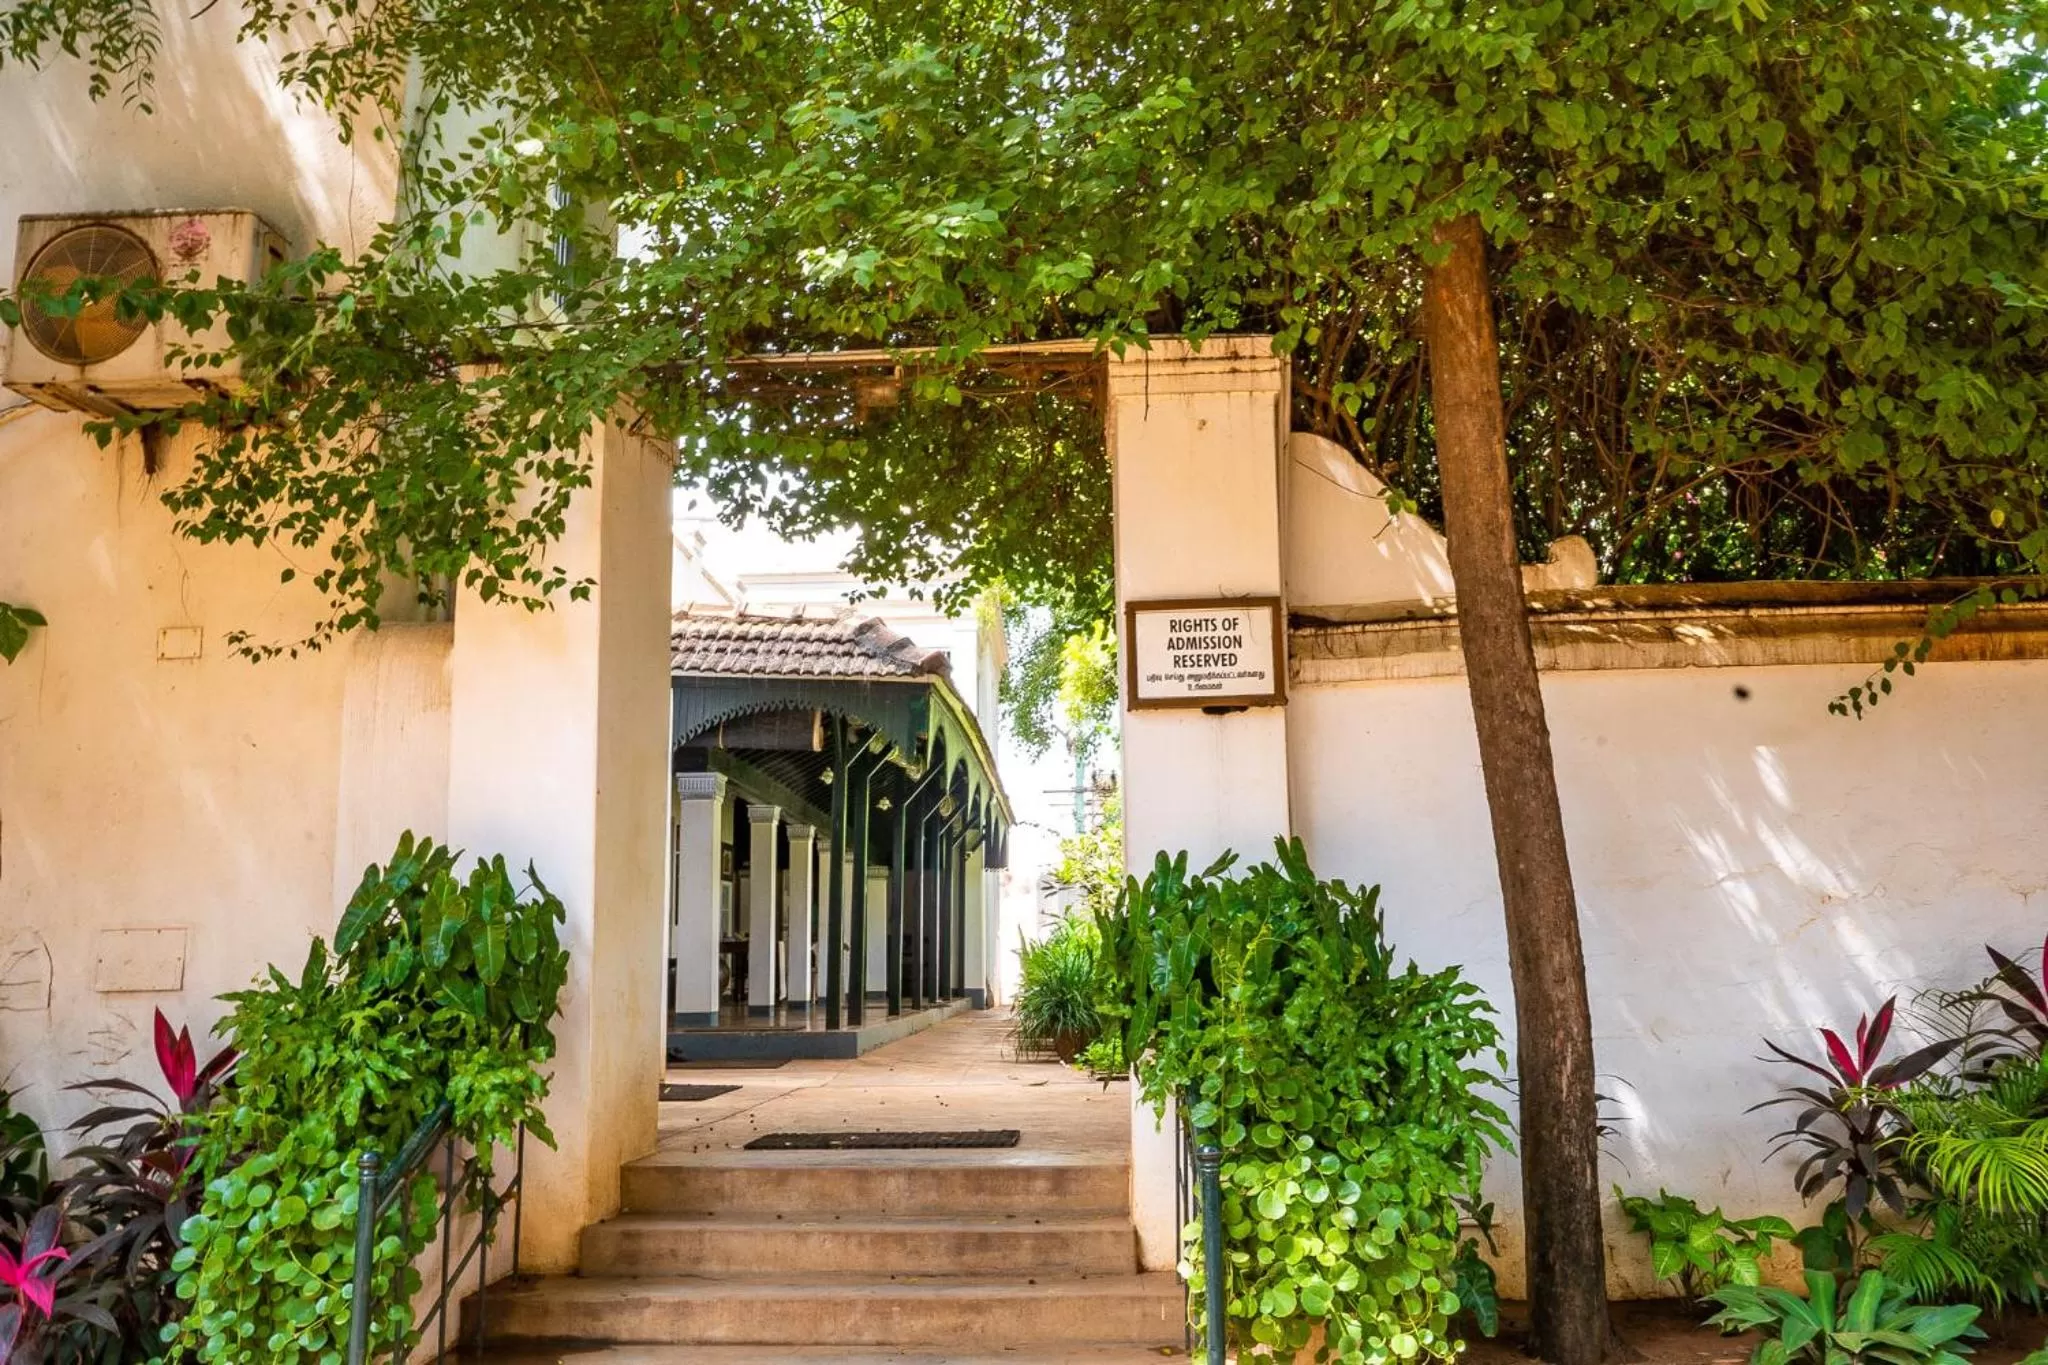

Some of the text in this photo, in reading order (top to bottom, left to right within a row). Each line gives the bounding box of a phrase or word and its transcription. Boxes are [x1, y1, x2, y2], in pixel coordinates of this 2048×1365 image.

[1169, 617, 1240, 633] RIGHTS OF
[1166, 635, 1243, 651] ADMISSION
[1173, 653, 1238, 668] RESERVED
